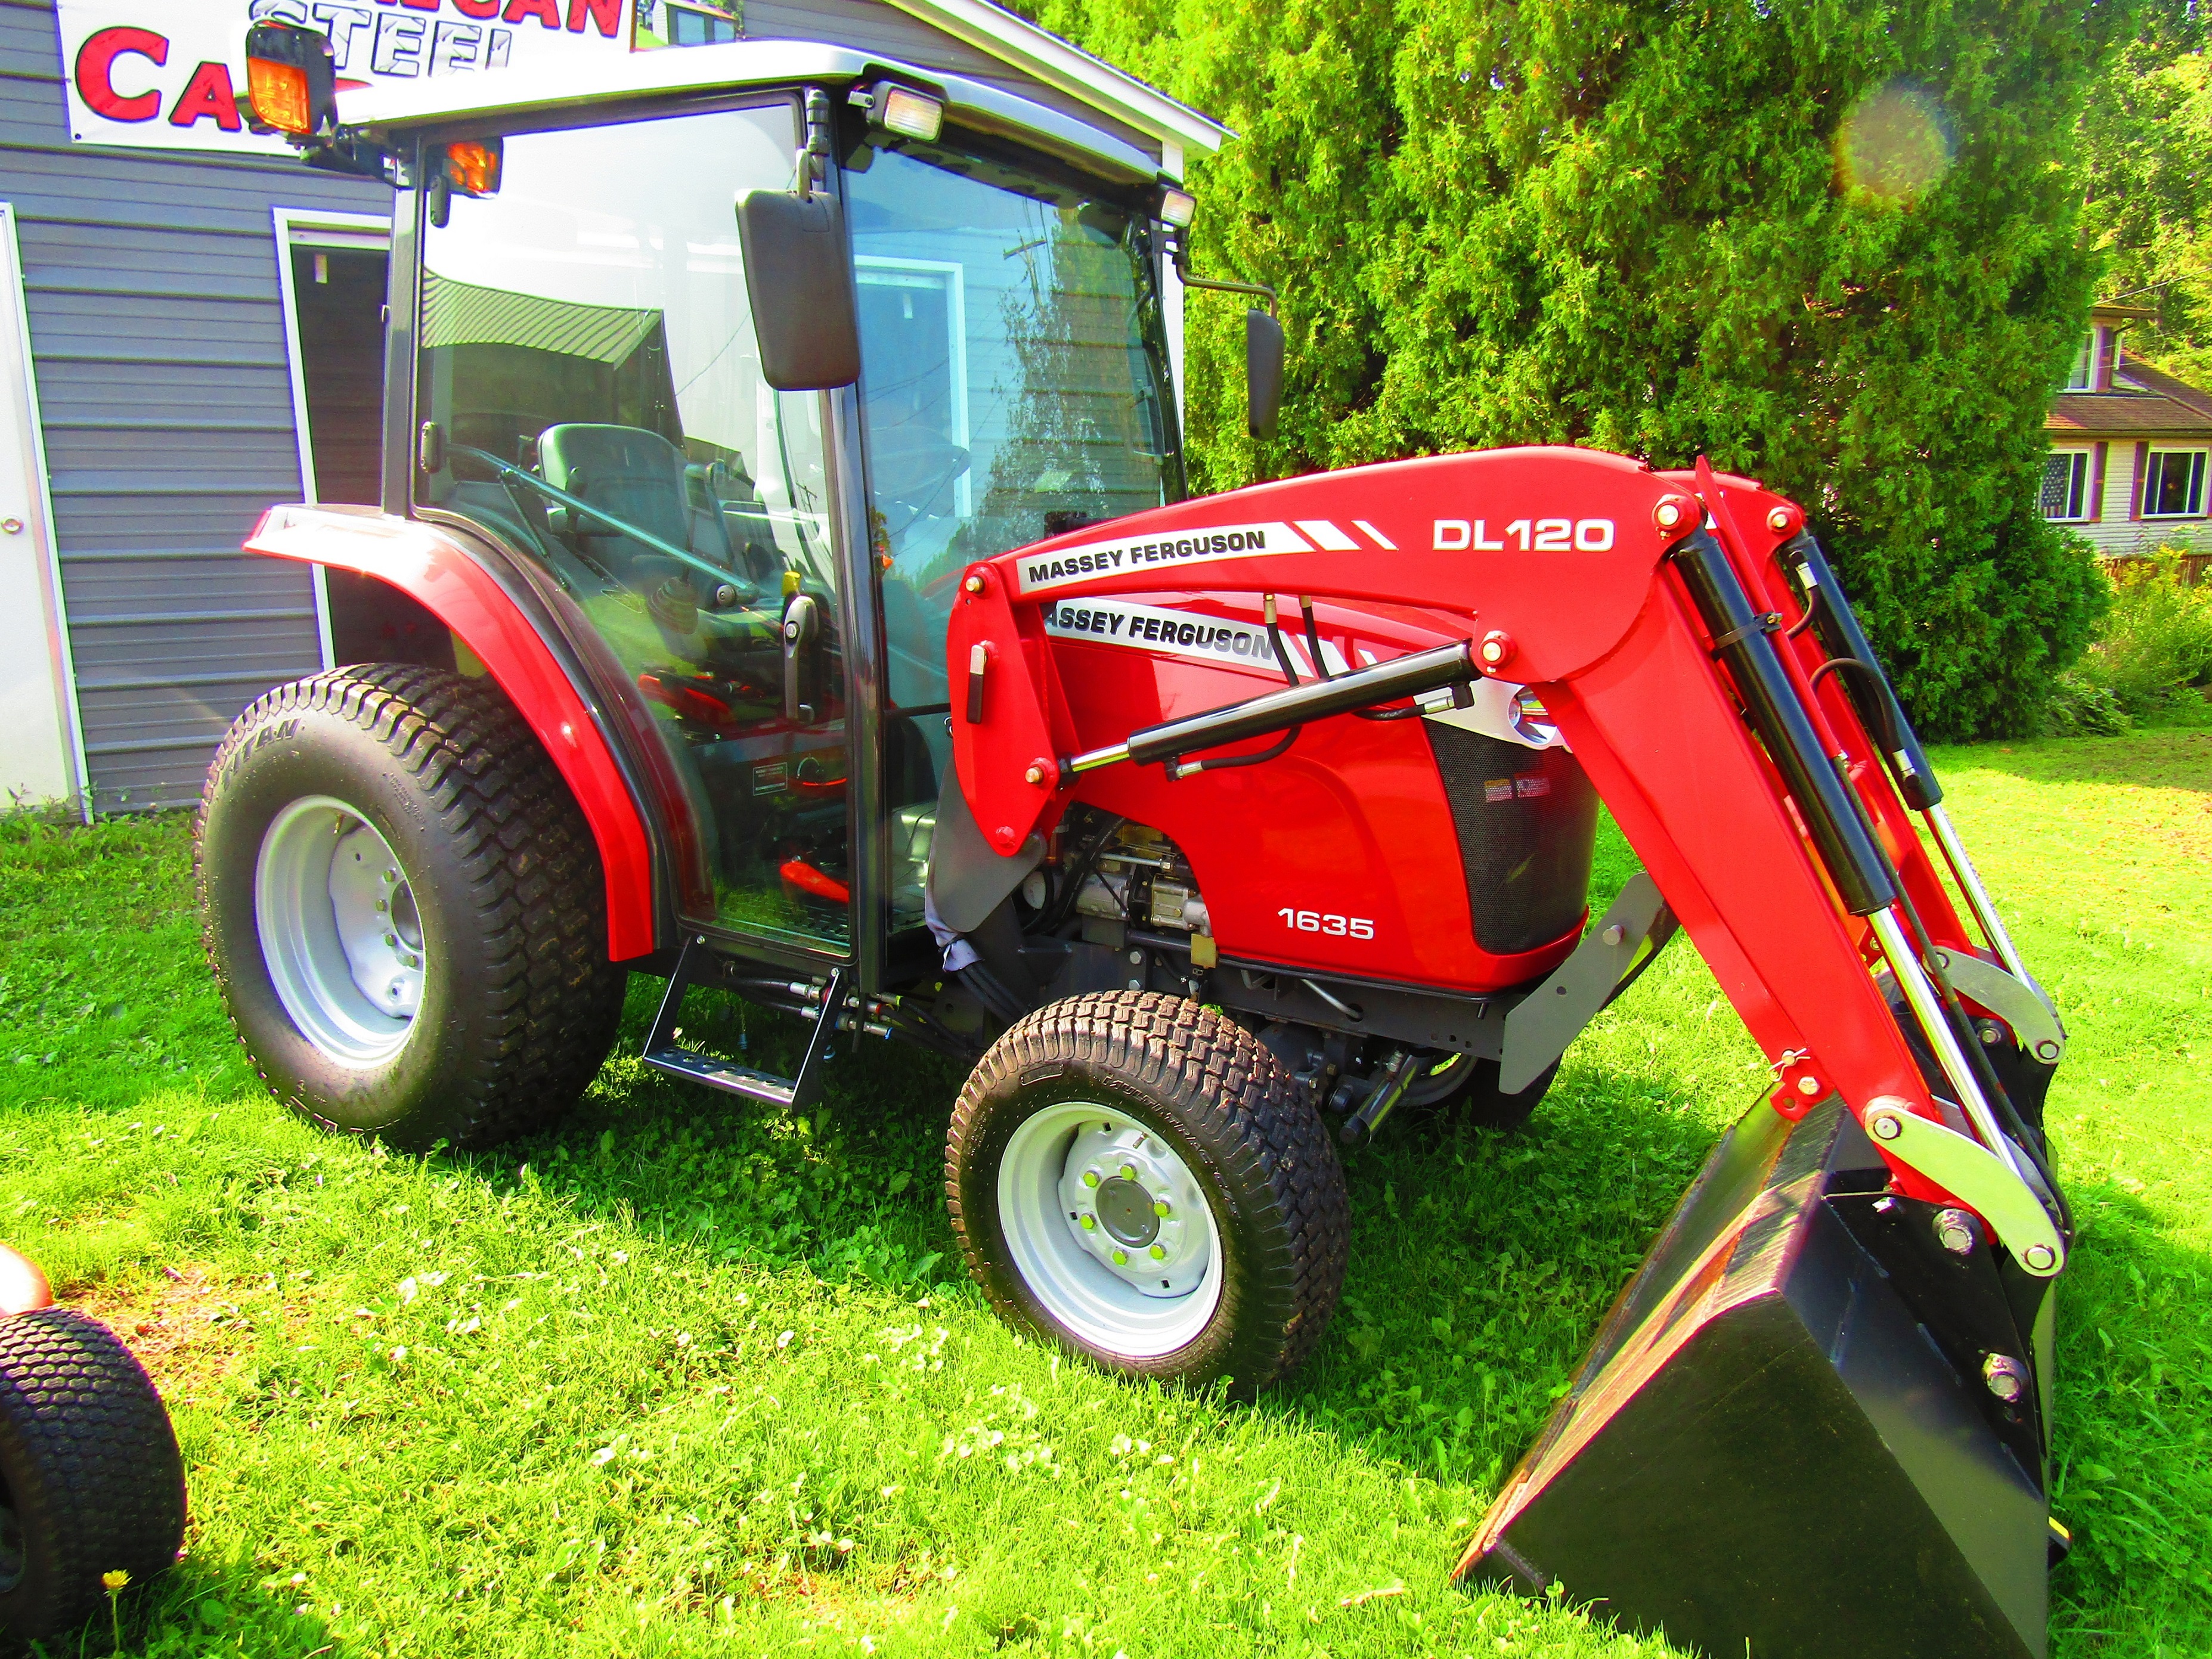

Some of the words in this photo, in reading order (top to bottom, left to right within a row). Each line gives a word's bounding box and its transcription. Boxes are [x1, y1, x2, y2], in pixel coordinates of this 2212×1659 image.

[1432, 518, 1615, 552] DL120
[1028, 550, 1123, 584] MASSEY
[1130, 531, 1266, 564] FERGUSON
[1045, 607, 1125, 635] ASSEY
[1129, 616, 1274, 660] FERGUSON
[1277, 907, 1374, 940] 1635
